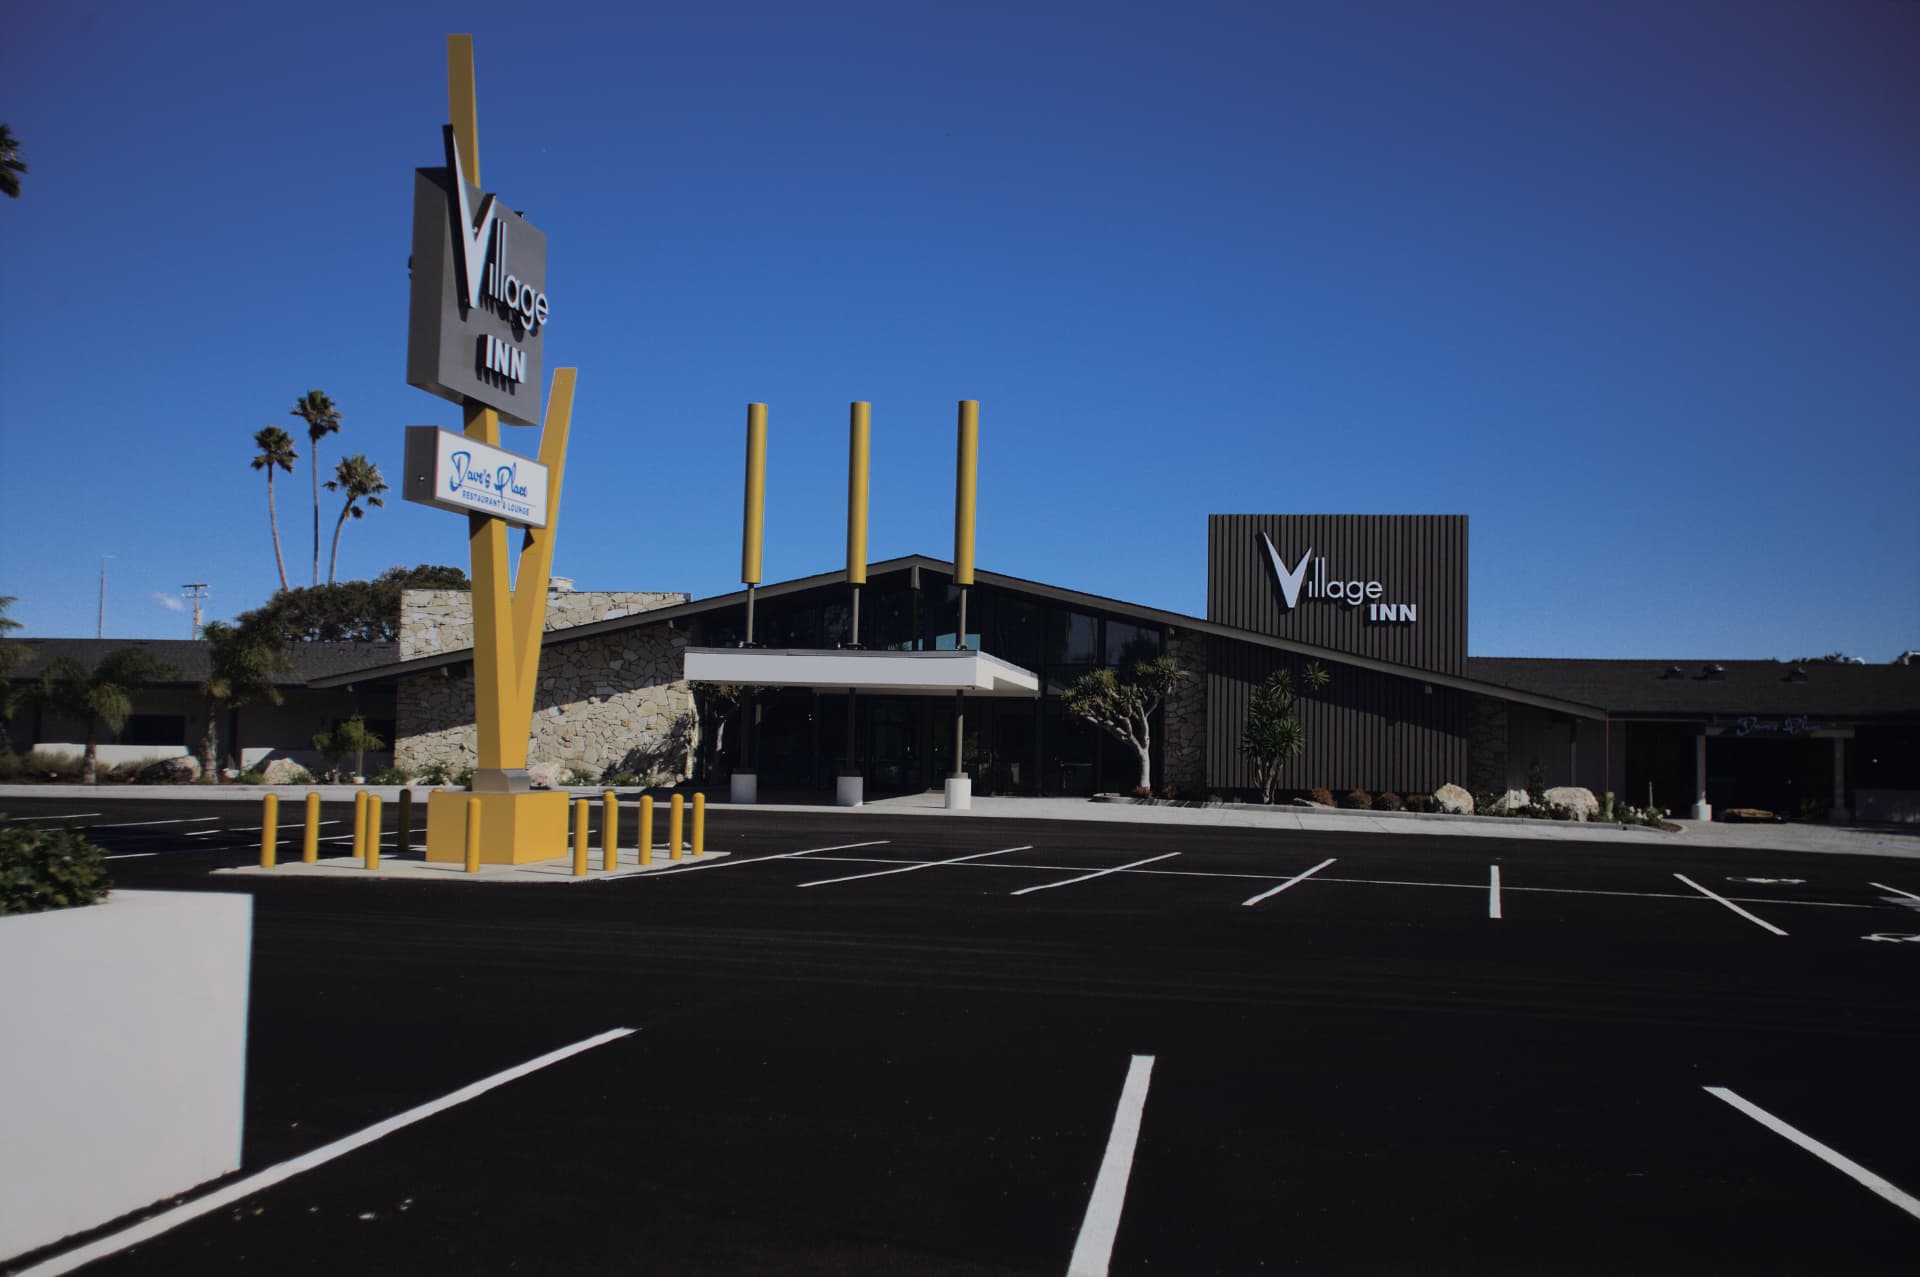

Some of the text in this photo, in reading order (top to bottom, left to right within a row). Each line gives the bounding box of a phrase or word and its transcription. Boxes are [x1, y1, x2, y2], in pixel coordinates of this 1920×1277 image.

[450, 128, 549, 330] Village
[485, 334, 527, 384] INN
[449, 450, 527, 500] Dave's Place
[461, 490, 501, 507] RESTAURANT
[508, 503, 529, 515] LOUNGE
[1263, 531, 1383, 608] Village
[1369, 604, 1417, 621] INN
